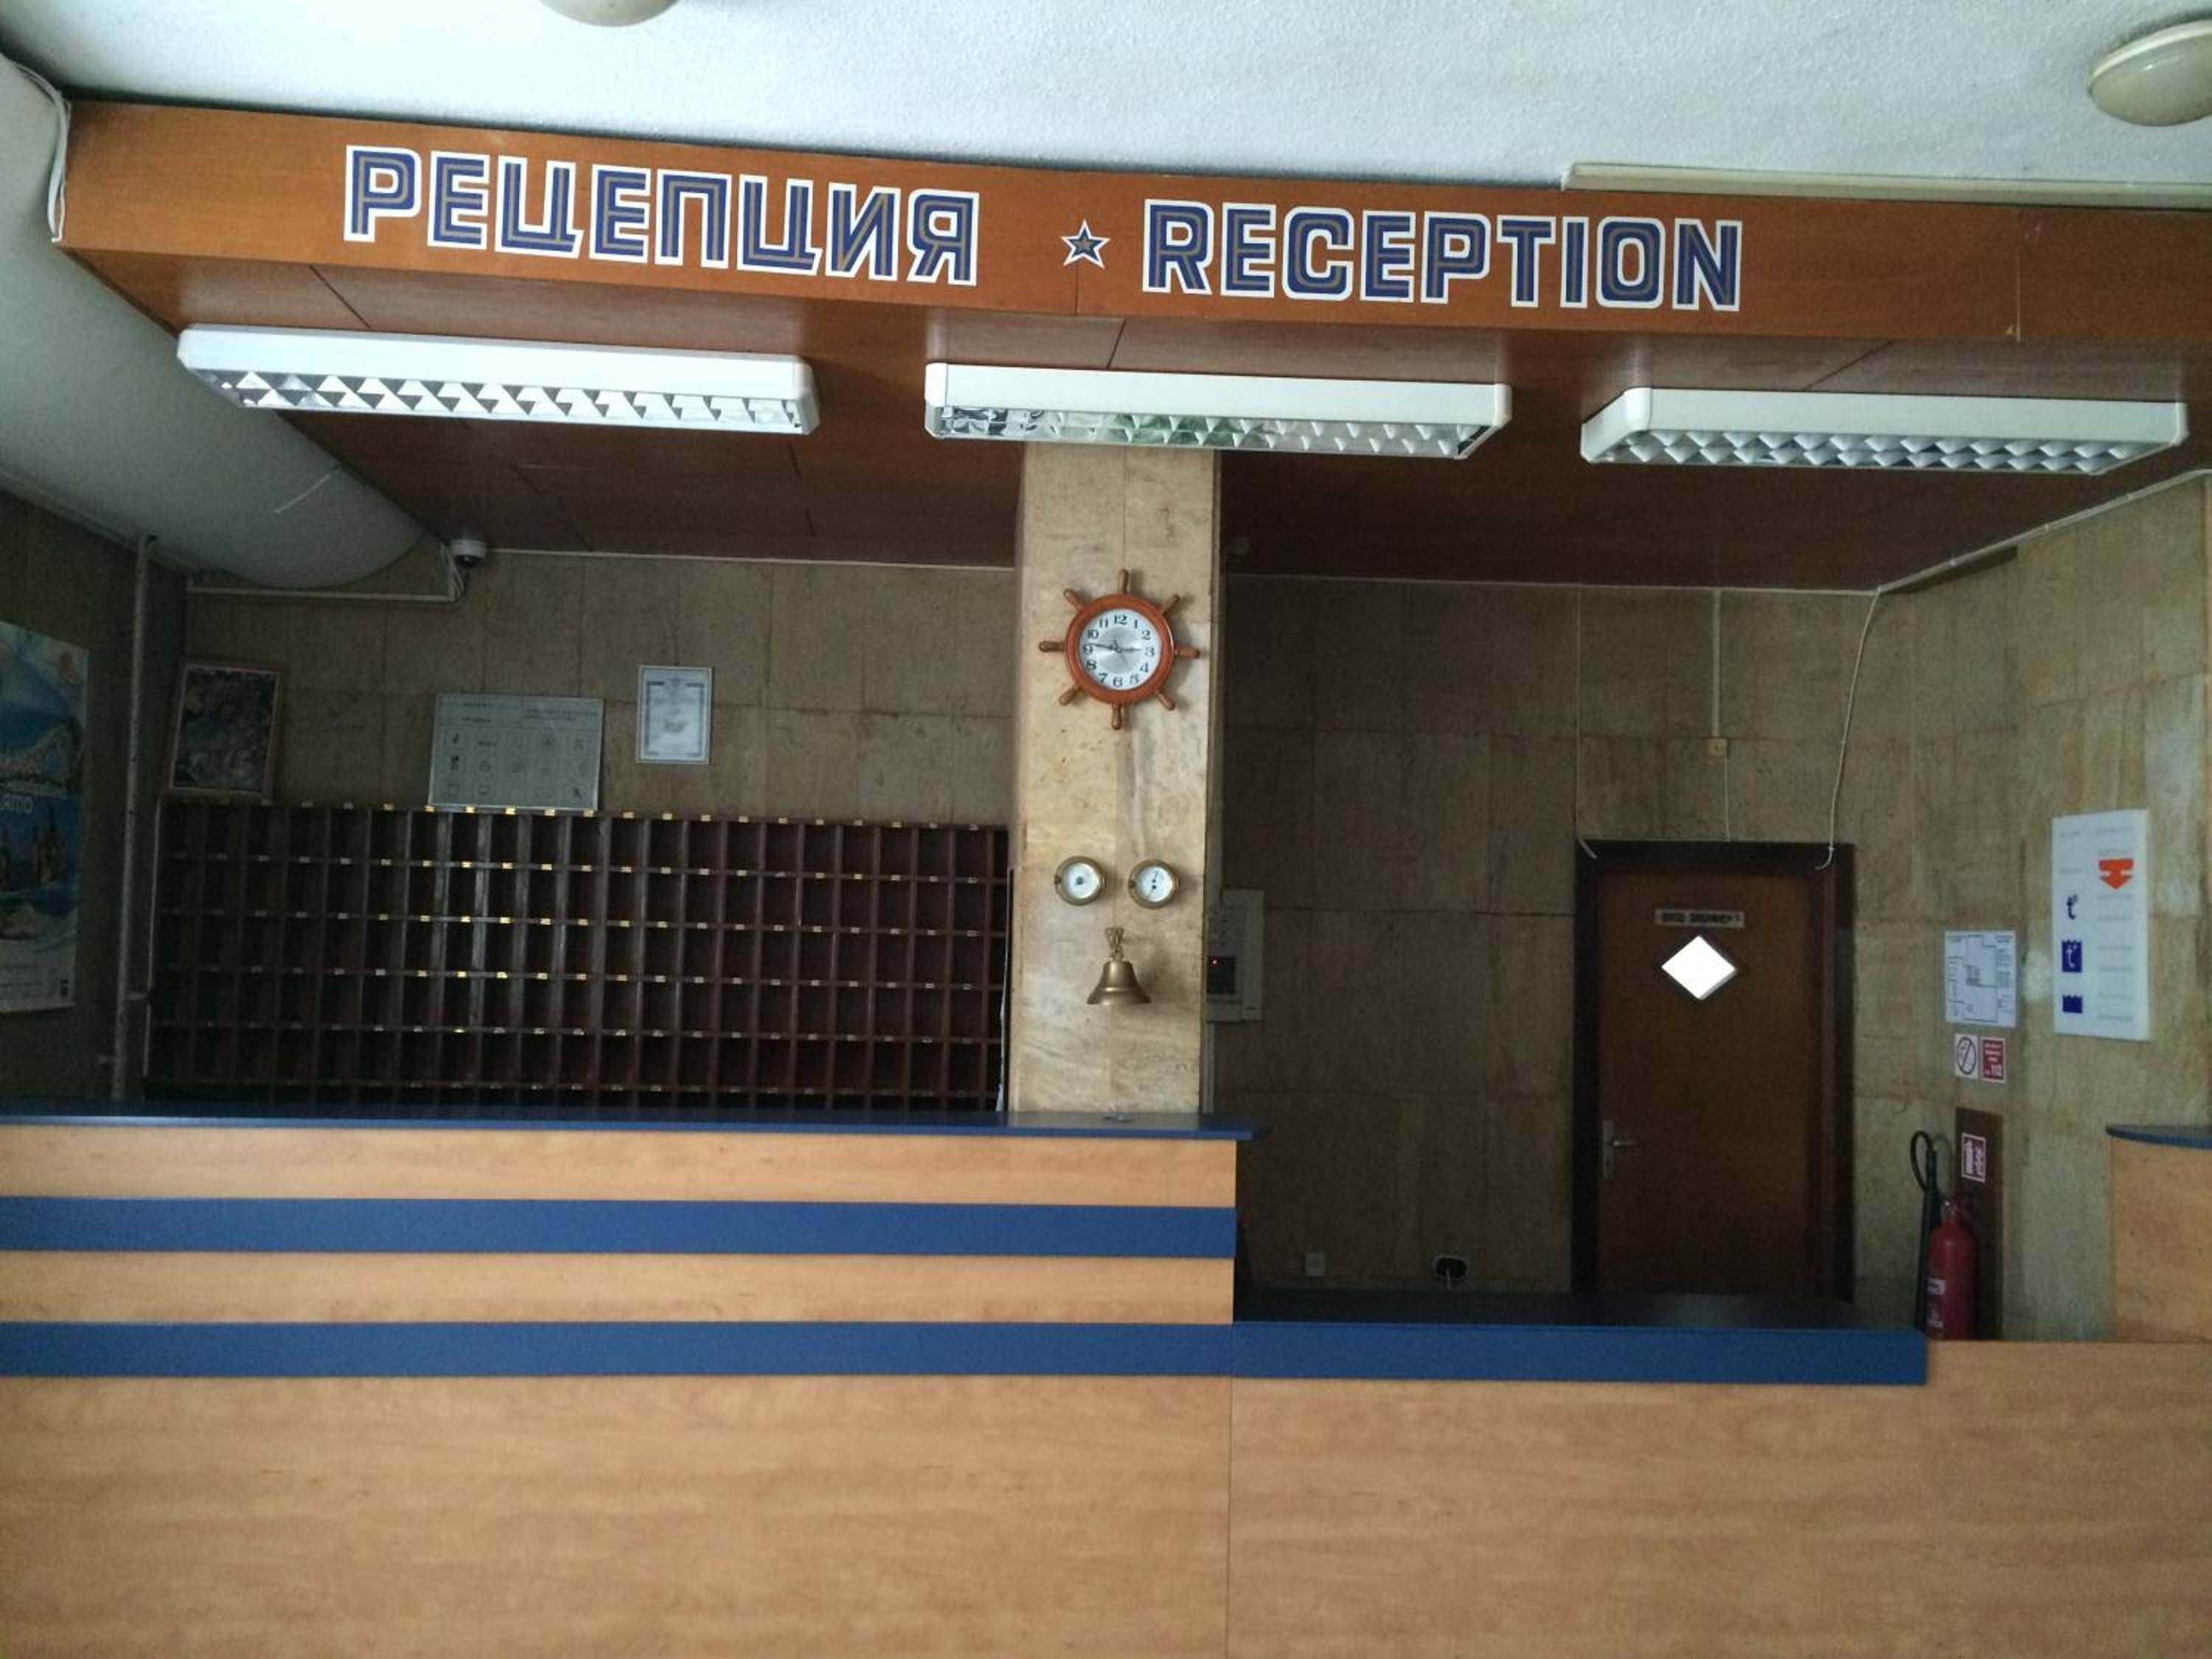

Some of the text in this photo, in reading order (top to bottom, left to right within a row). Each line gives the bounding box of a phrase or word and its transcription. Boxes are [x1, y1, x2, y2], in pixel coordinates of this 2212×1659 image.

[344, 145, 979, 286] РЕЦЕПЦИЯ
[1141, 198, 1742, 312] RECEPTION
[1099, 618, 1108, 627] 11
[1114, 614, 1127, 625] 12
[1087, 629, 1099, 639] 10
[1141, 630, 1150, 640] 2
[1082, 644, 1093, 655] 9
[1144, 647, 1155, 657] 3
[1086, 660, 1097, 670] 8
[1139, 662, 1149, 672] 4
[1098, 672, 1108, 683] 7
[1113, 676, 1123, 688] 6
[1130, 674, 1139, 684] 5
